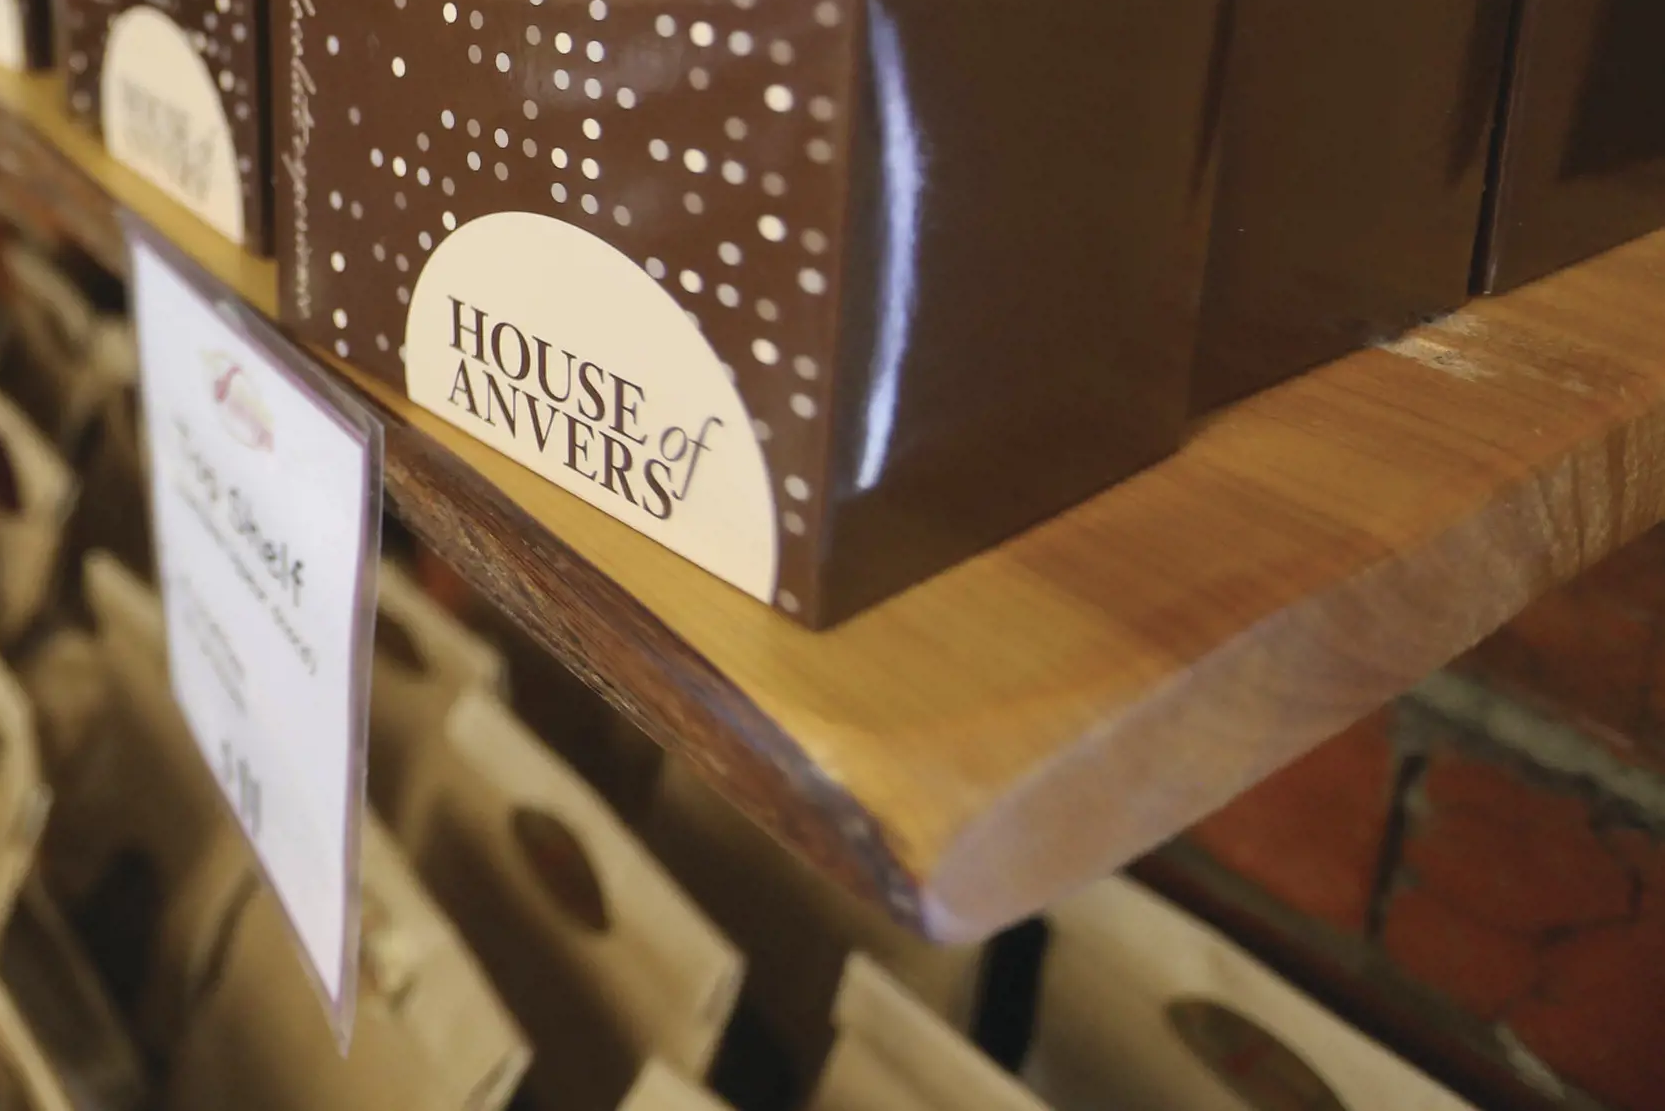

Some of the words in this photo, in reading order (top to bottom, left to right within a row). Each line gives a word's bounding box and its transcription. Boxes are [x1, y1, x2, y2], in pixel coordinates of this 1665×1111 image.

[447, 294, 648, 446] HOUSE
[659, 415, 724, 502] of
[447, 358, 676, 521] ANVERS
